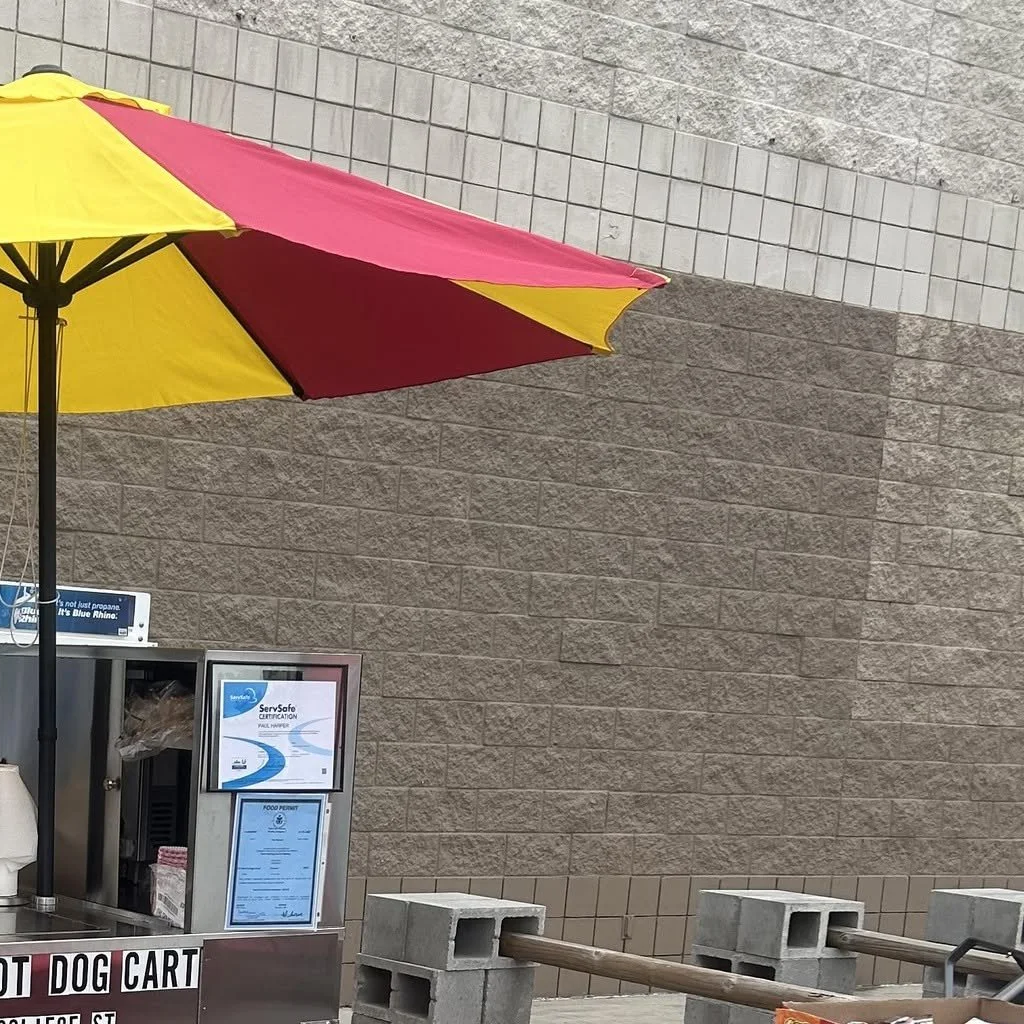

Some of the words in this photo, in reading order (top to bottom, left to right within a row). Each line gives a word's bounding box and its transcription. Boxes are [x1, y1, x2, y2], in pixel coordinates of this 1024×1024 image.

[79, 602, 91, 611] just
[58, 608, 71, 616] It's
[73, 610, 90, 618] Blue
[259, 704, 296, 713] ServSafe
[51, 953, 109, 995] DOG
[124, 948, 198, 991] CART
